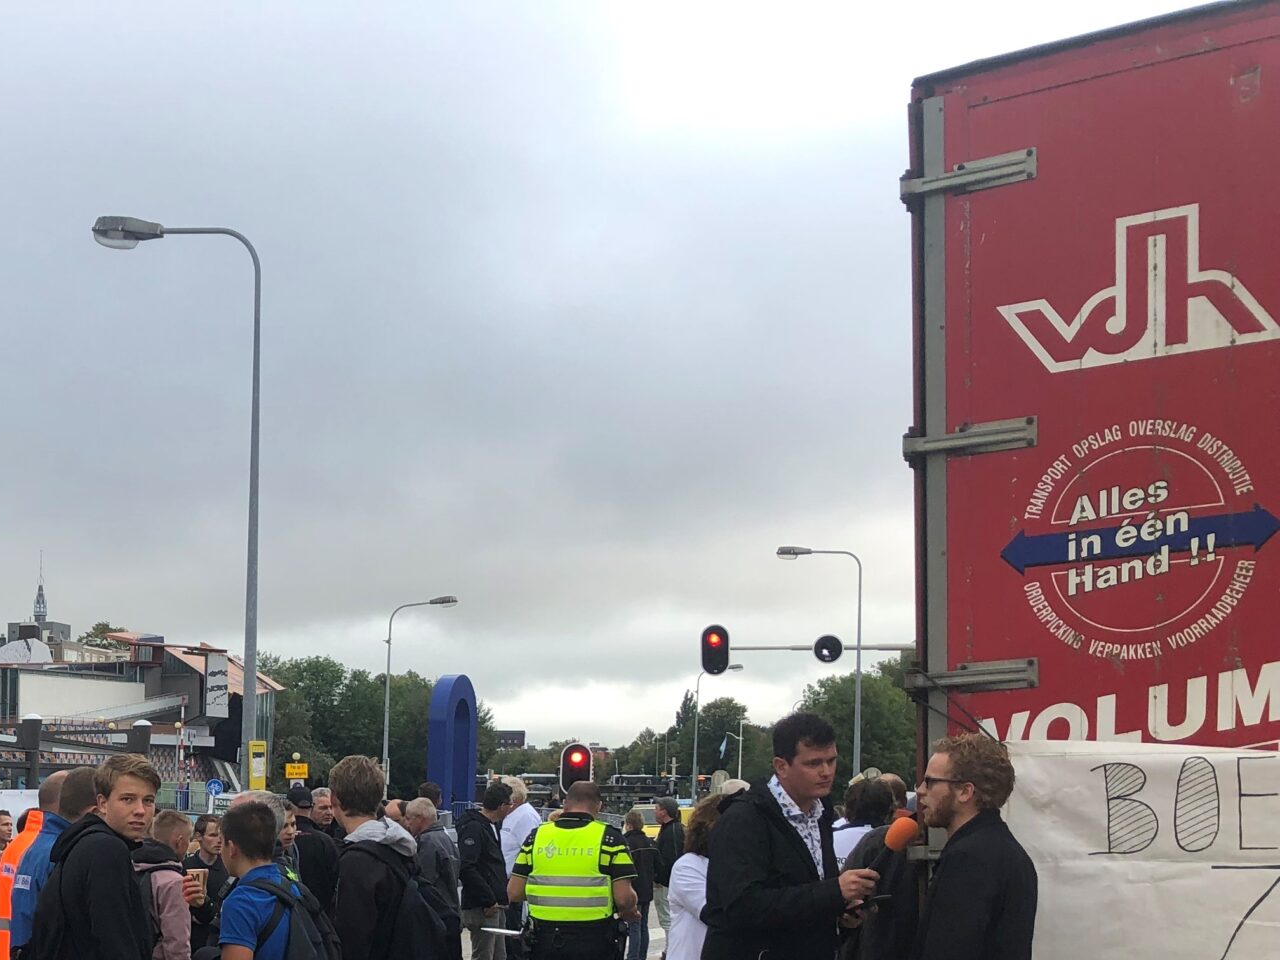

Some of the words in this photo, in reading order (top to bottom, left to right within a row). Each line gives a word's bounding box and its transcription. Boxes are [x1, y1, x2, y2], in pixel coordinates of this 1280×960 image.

[1024, 454, 1073, 520] TRANSPORT
[1072, 424, 1122, 458] OPSLAG
[1128, 419, 1197, 443] OVERSLAG
[1196, 432, 1255, 496] DISTRIBUTIE
[1069, 480, 1168, 526] Alles
[1067, 532, 1102, 561] in
[1115, 511, 1189, 548] één
[1067, 545, 1169, 596] Hand
[1024, 581, 1085, 649] ORDERPICKING
[1166, 559, 1257, 650] VOORRAADBEHEER
[1088, 756, 1279, 855] BOE
